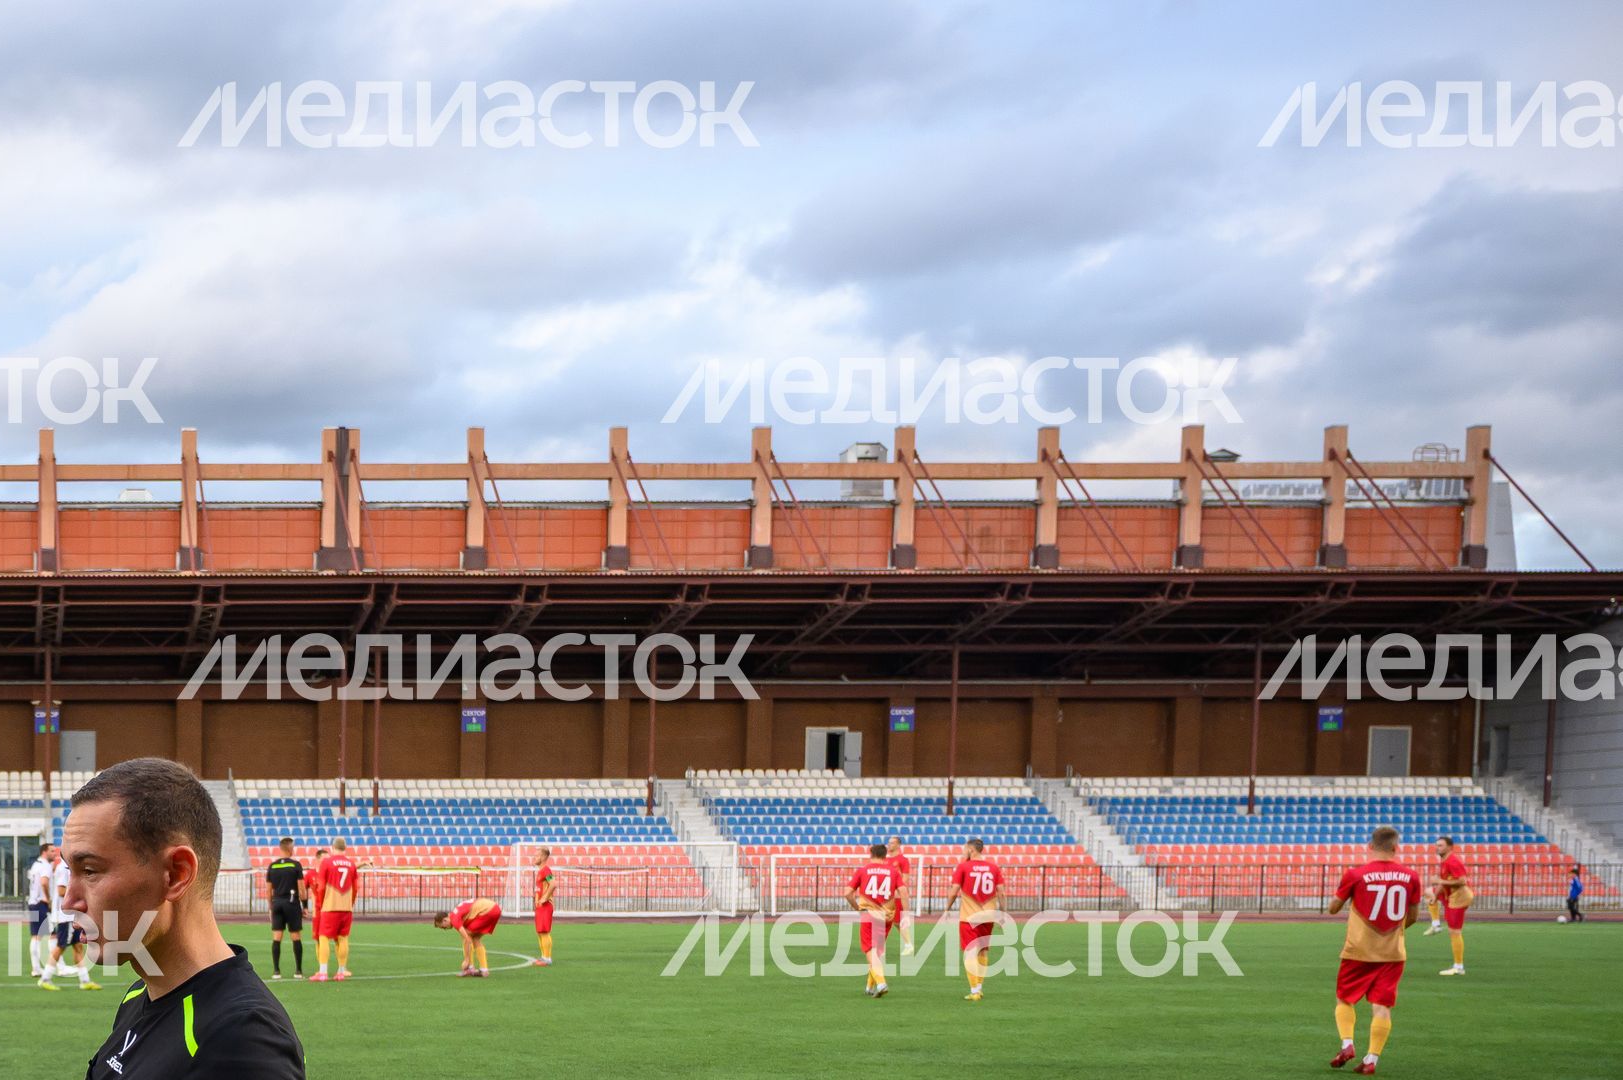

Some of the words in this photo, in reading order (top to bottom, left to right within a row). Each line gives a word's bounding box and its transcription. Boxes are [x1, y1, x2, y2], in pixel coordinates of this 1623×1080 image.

[337, 867, 348, 888] 7
[864, 875, 891, 900] 44
[969, 872, 994, 895] 76
[1363, 871, 1411, 884] КУКУШКИН
[1366, 884, 1407, 921] 70
